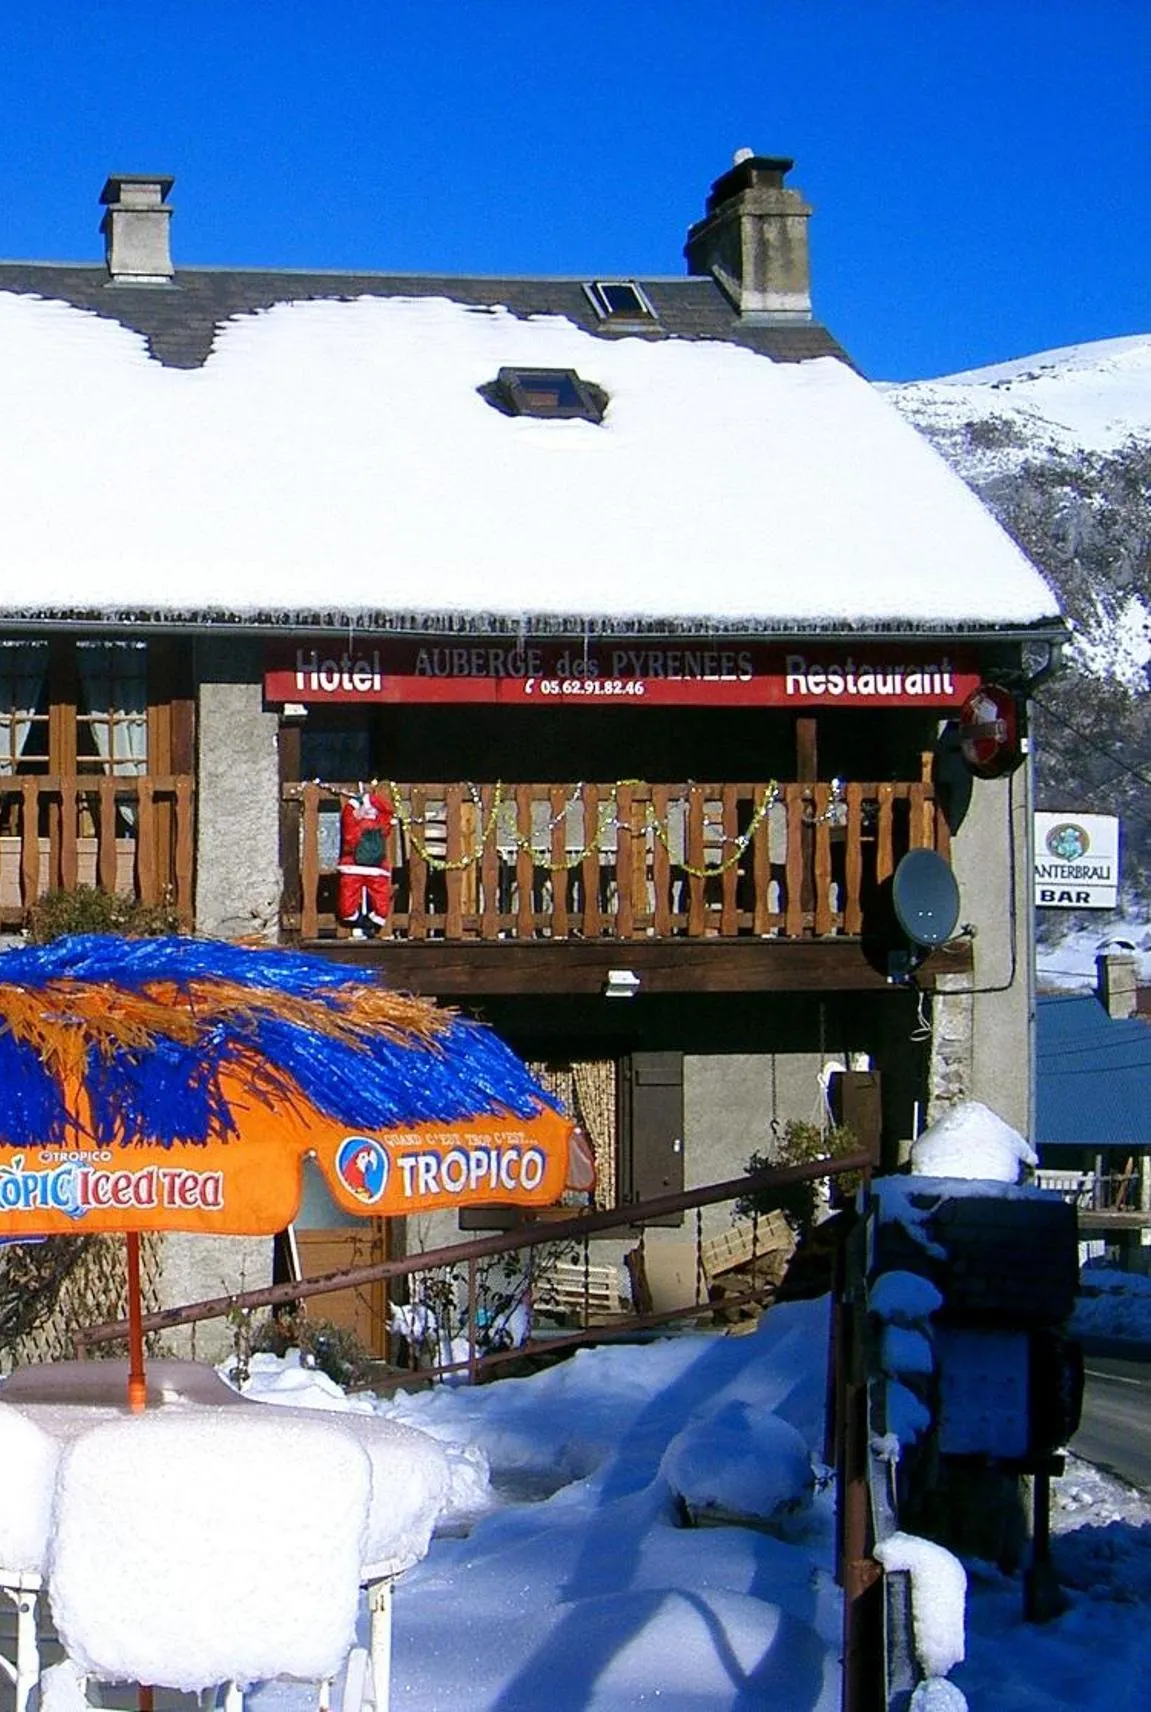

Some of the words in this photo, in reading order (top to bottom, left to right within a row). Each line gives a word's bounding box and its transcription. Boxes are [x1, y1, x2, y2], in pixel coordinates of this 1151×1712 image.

[296, 648, 382, 692] Hotel
[413, 647, 544, 678] AUBERGE
[555, 650, 601, 679] des
[611, 650, 754, 681] PYRENEES
[784, 653, 955, 696] Restaurant
[539, 679, 646, 697] 05.62.91.82.46
[1034, 863, 1111, 881] ANTERBRAU
[1039, 889, 1091, 904] BAR
[52, 1150, 112, 1164] TROPICO
[396, 1148, 545, 1198] TROPICO
[79, 1167, 157, 1210] Iced
[161, 1168, 224, 1210] Tea
